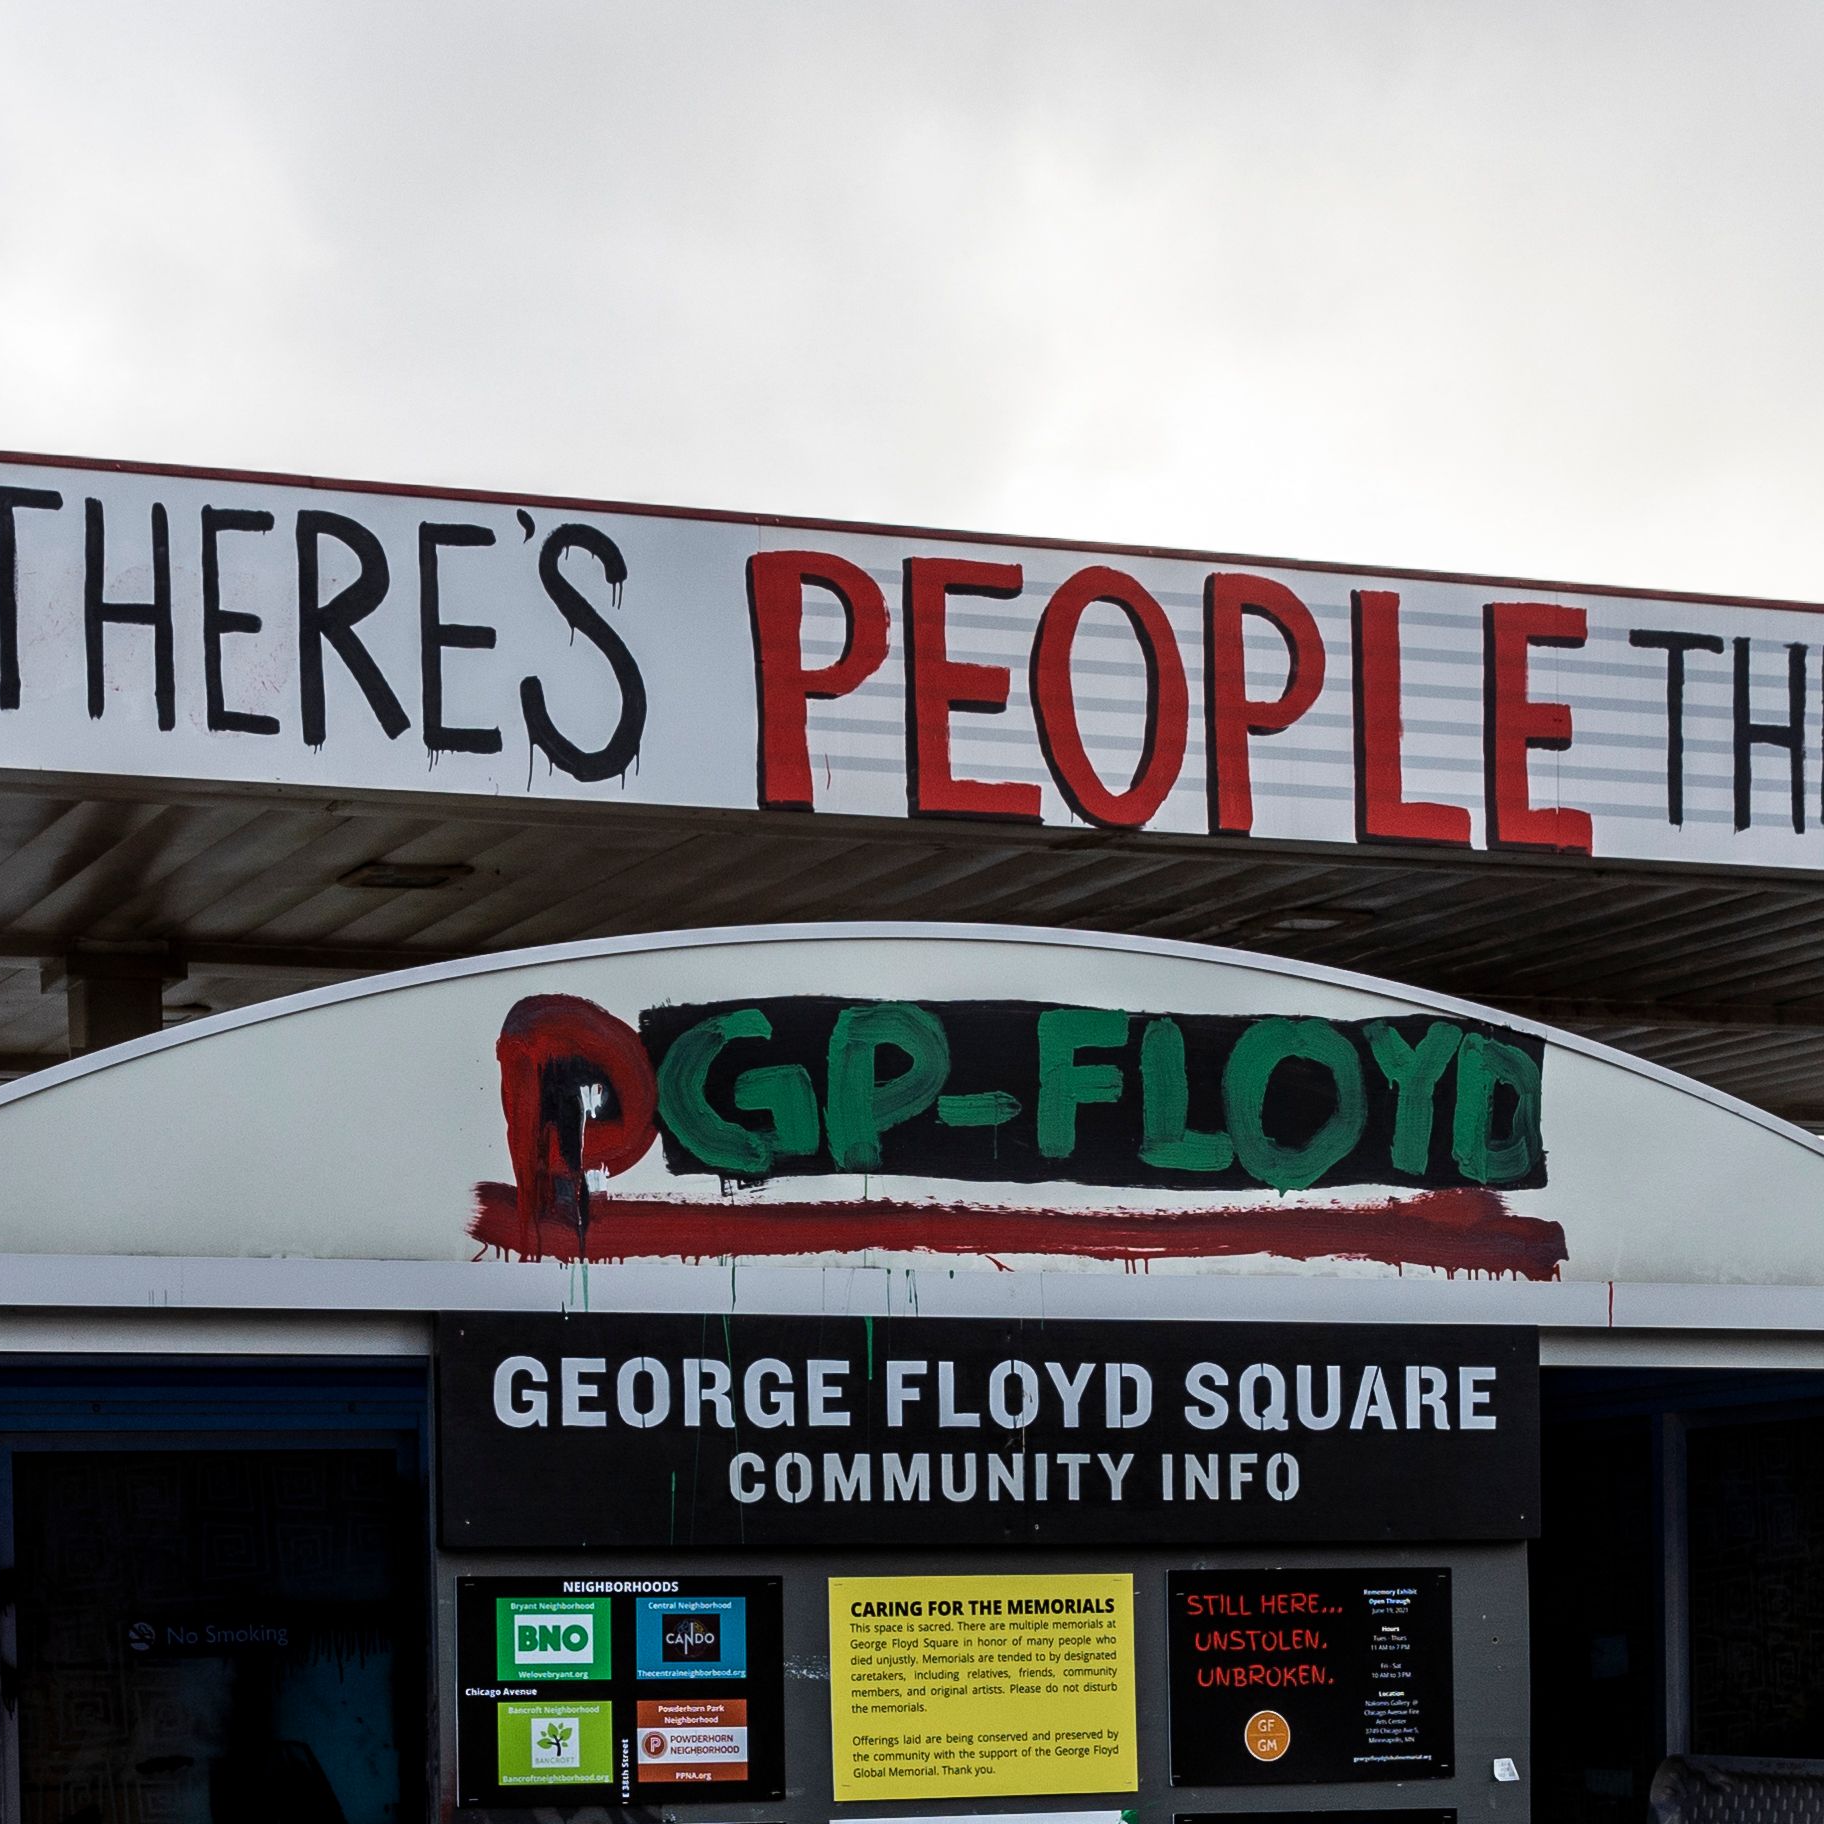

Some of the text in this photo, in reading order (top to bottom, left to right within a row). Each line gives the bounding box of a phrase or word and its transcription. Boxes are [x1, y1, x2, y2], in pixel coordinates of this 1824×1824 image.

[745, 549, 1596, 855] PEOPLE
[492, 1355, 1498, 1432] GEORGE FLOYD SQUARE
[727, 1451, 1302, 1505] COMMUNITY INFO
[563, 1581, 679, 1593] NEIGHBORHOODS
[851, 1598, 1115, 1617] CARING FOR THE MEMORIALS
[1187, 1593, 1343, 1616] STILL HERE...
[167, 1621, 288, 1646] No Smoking
[850, 1619, 1116, 1635] This space is sacred. There are multiple memorials at
[518, 1625, 589, 1652] BNO
[666, 1622, 714, 1656] CANDO
[1195, 1630, 1328, 1651] UNSTOLEN.
[518, 1670, 588, 1679] Welovebryant.org
[1198, 1665, 1334, 1687] UNBROKEN.
[465, 1687, 537, 1697] Chicago Avenue
[658, 1705, 724, 1713] Powderhorn Park
[1258, 1720, 1275, 1732] GF
[670, 1734, 733, 1744] POWDERHORN
[1258, 1739, 1278, 1752] GM
[670, 1745, 740, 1755] NEIGHBORHOOD
[536, 1757, 575, 1765] BANCROFT
